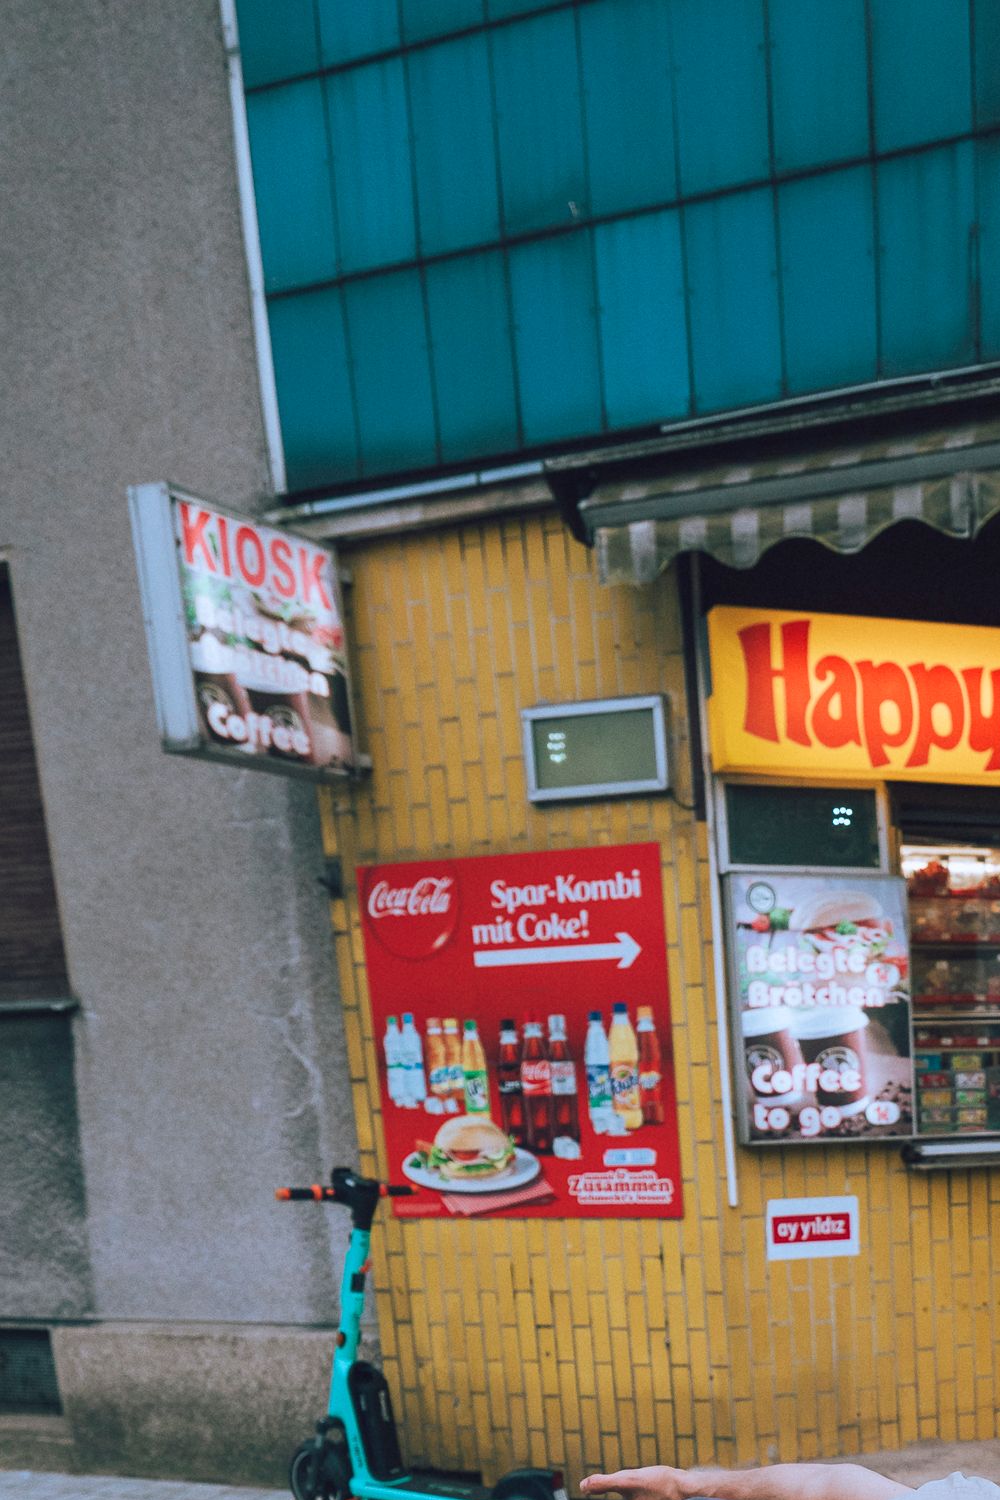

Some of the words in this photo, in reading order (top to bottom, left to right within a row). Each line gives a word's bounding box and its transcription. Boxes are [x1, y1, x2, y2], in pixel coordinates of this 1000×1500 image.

[179, 502, 333, 611] KIOSK
[207, 702, 310, 755] Coffee
[490, 868, 642, 915] Spar-Kombi
[472, 915, 514, 945] mit
[516, 909, 590, 943] Coke!
[746, 944, 868, 980] Belegte
[748, 979, 887, 1009] Brötchen
[751, 1062, 863, 1094] Coffee
[754, 1103, 791, 1132] to
[799, 1105, 844, 1138] go
[568, 1177, 671, 1193] Zusammen
[777, 1221, 799, 1241] ay
